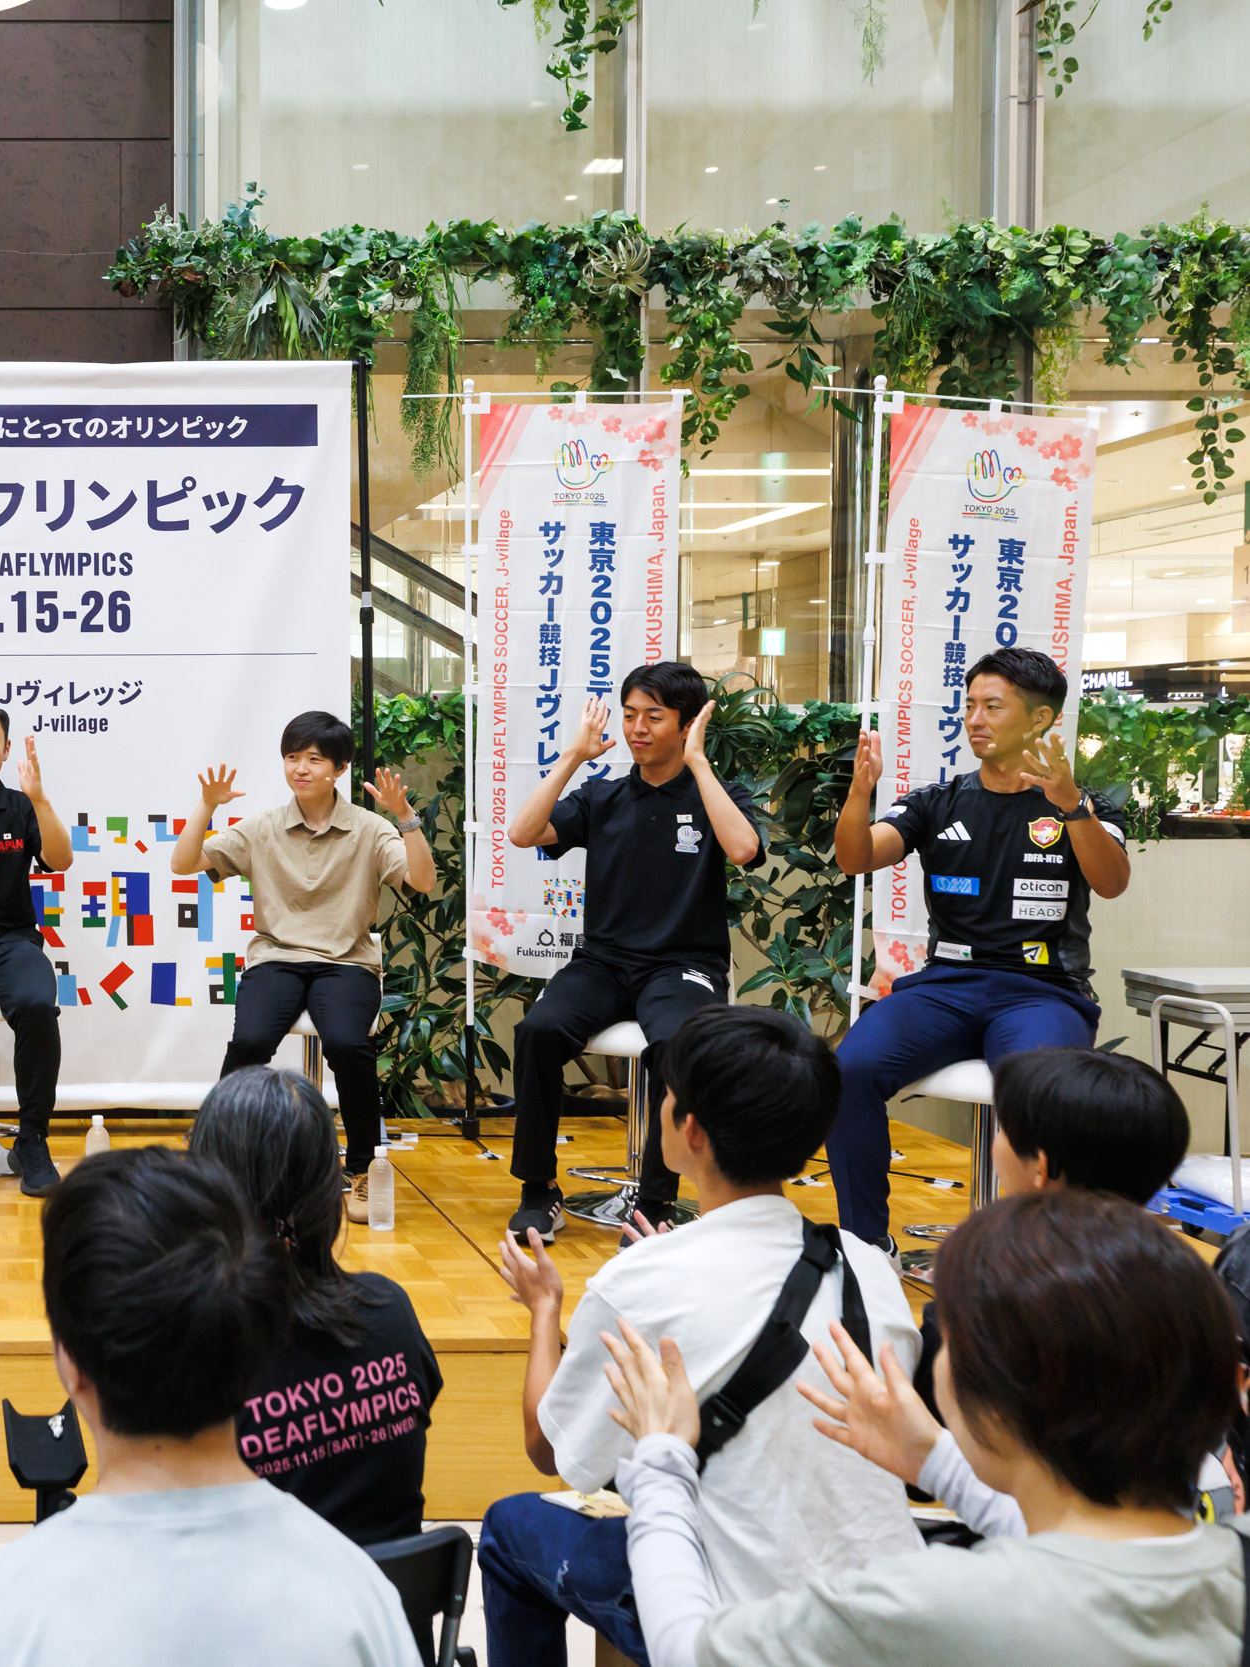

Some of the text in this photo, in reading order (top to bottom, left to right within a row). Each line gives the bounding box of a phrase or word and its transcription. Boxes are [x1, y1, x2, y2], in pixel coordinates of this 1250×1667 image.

[554, 492, 581, 500] TOKYO
[648, 479, 668, 541] Japan.
[964, 505, 1016, 516] TOKYO 2025
[1059, 500, 1079, 566] Japan.
[902, 517, 922, 589] J-village
[900, 595, 918, 674] SOCCER,
[0, 679, 143, 707] Jヴィレッジ
[1081, 671, 1133, 689] CHANEL
[491, 509, 513, 888] TOKYO 2025 DEAFLYMPICS SOCCER, J-village
[32, 714, 109, 737] J-village
[1020, 881, 1063, 892] oticon
[1019, 908, 1062, 917] HEADS
[517, 947, 569, 959] Fukushima
[244, 1352, 407, 1424] TOKYO 2025
[240, 1382, 421, 1459] DEAFLYMPICS
